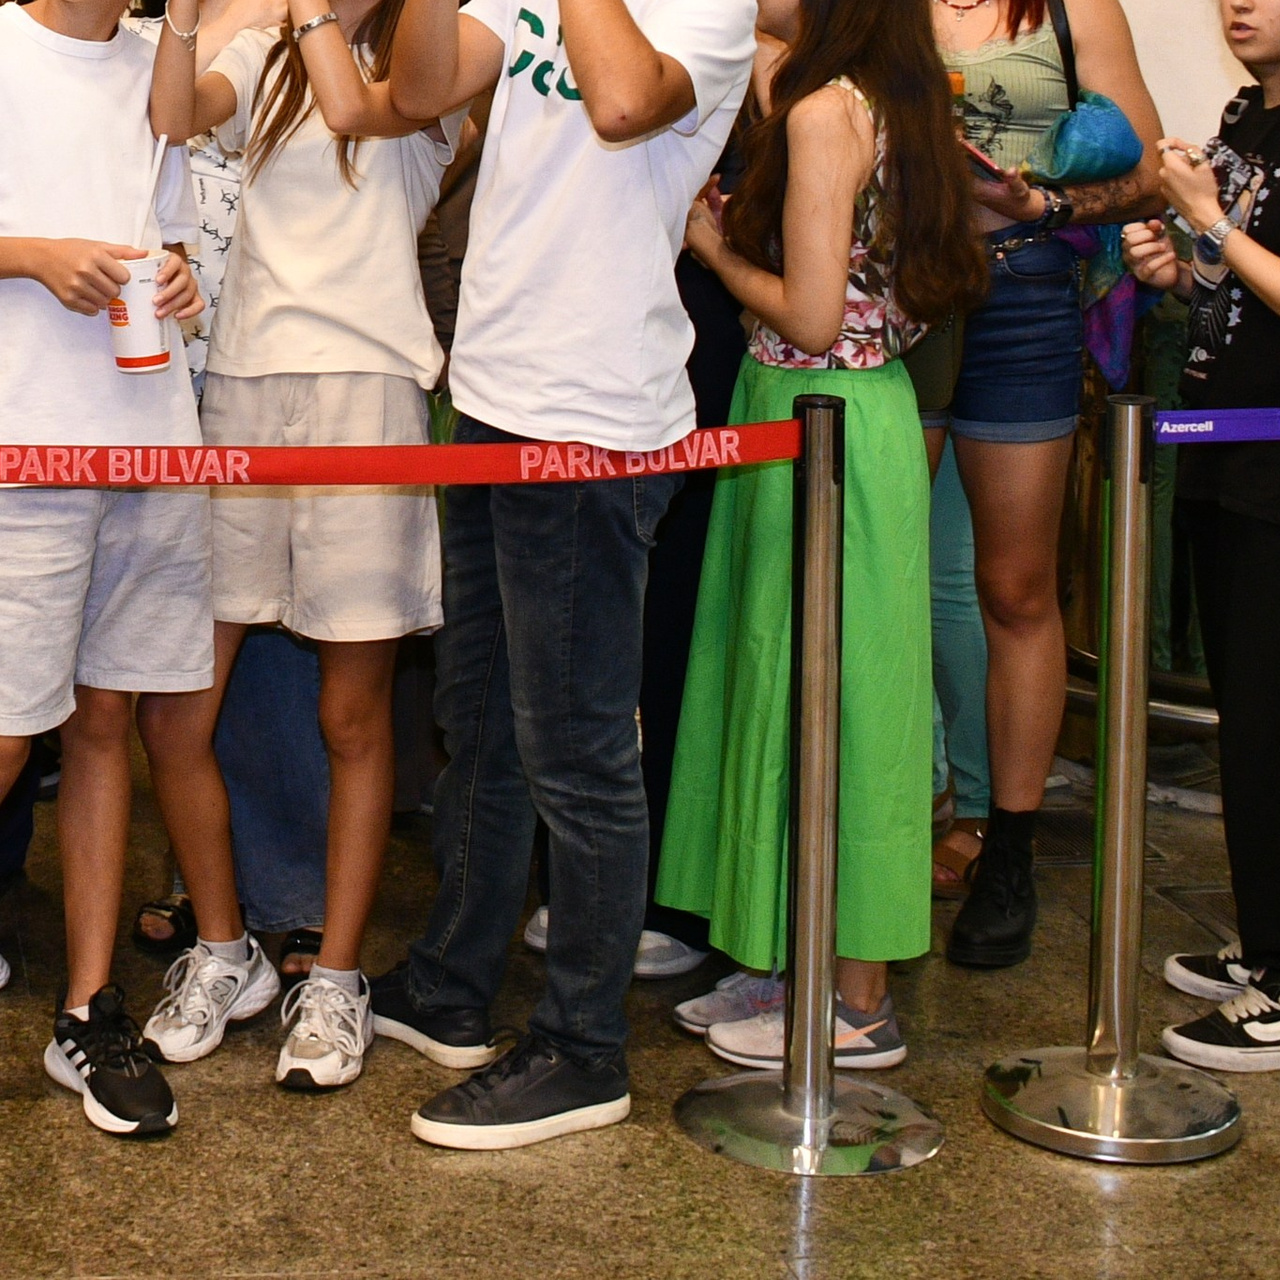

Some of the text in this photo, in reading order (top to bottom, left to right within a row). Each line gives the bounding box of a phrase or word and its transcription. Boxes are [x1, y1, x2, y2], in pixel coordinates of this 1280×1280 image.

[1160, 421, 1214, 433] Azercell
[0, 447, 251, 483] PARK BULVAR
[520, 443, 617, 480] PARK
